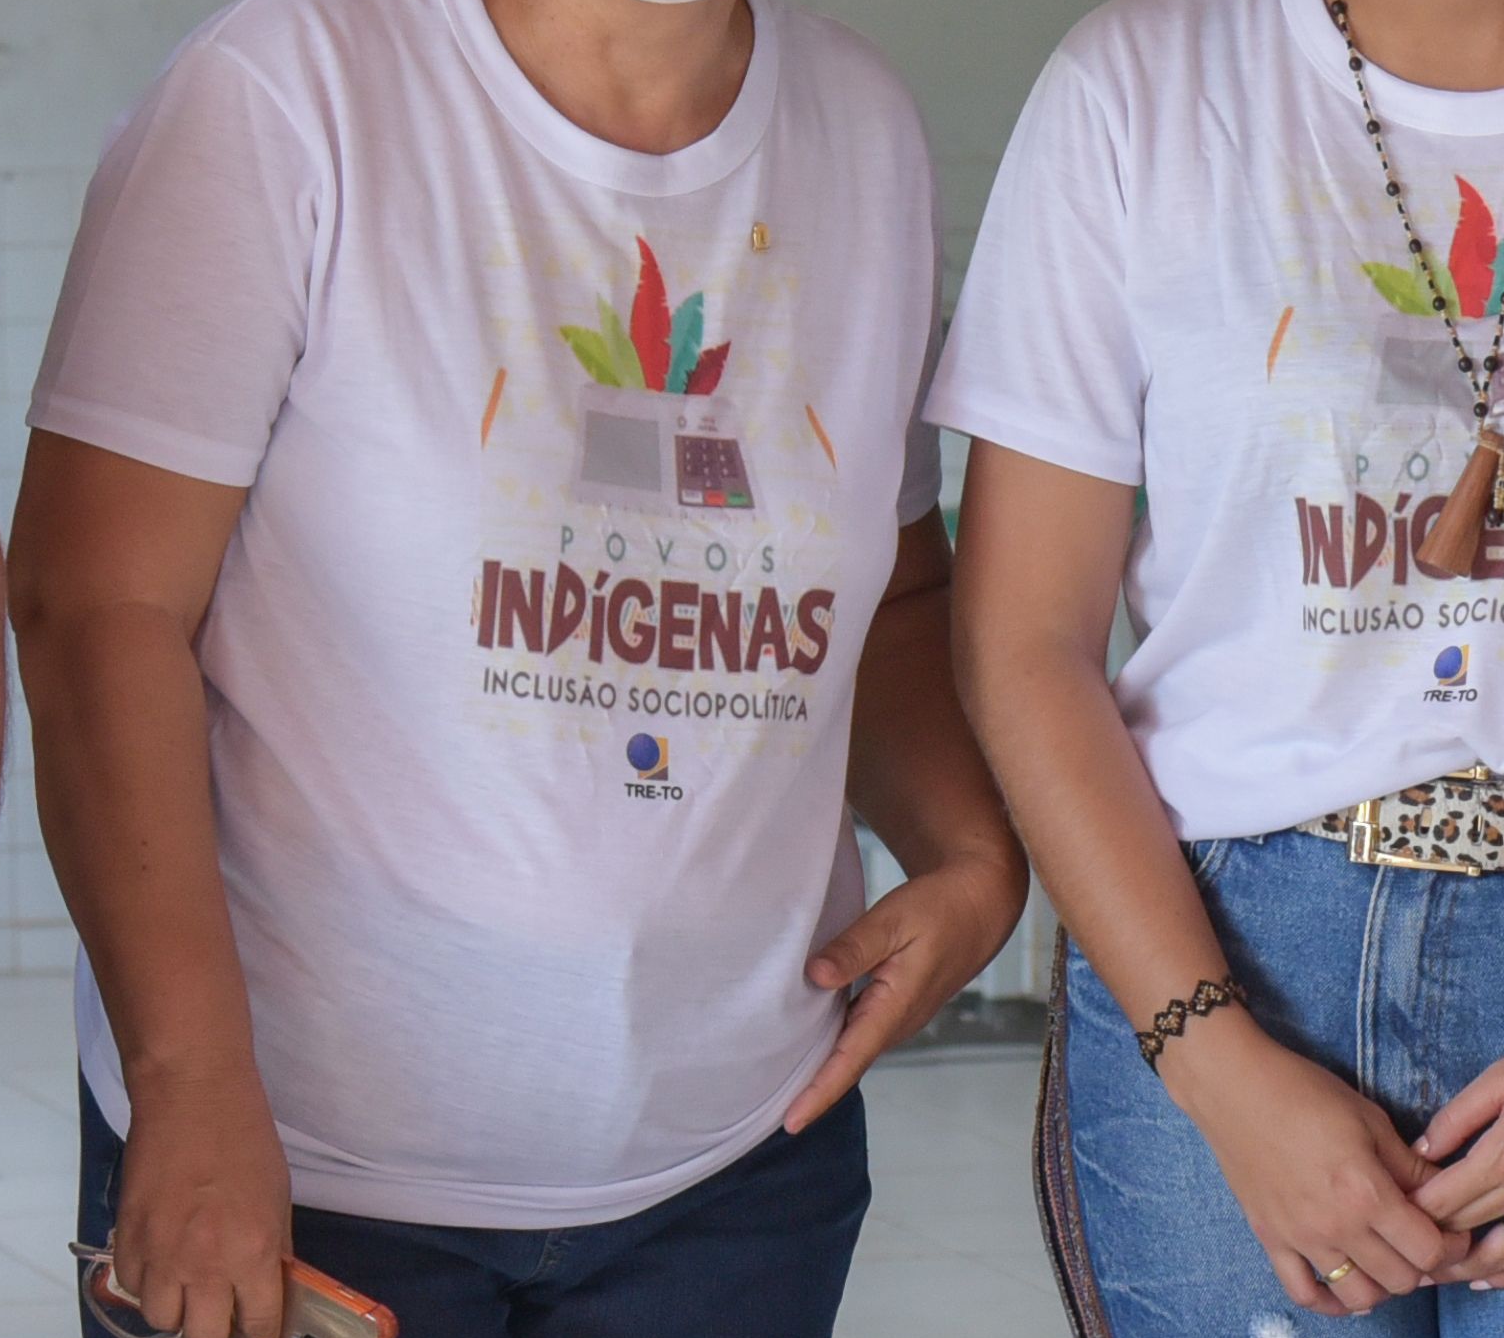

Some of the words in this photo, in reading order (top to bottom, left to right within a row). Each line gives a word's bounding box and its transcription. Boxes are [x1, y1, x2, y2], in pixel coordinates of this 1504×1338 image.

[560, 525, 775, 573] POVOS
[476, 560, 836, 675] INDÍGENAS
[1302, 600, 1424, 635] INCLUSÃO
[482, 667, 617, 709] INCLUSÃO
[627, 687, 808, 722] SOCIOPOLÍTICA
[1422, 688, 1478, 703] TRE-TO
[624, 783, 683, 801] TRE-TO
